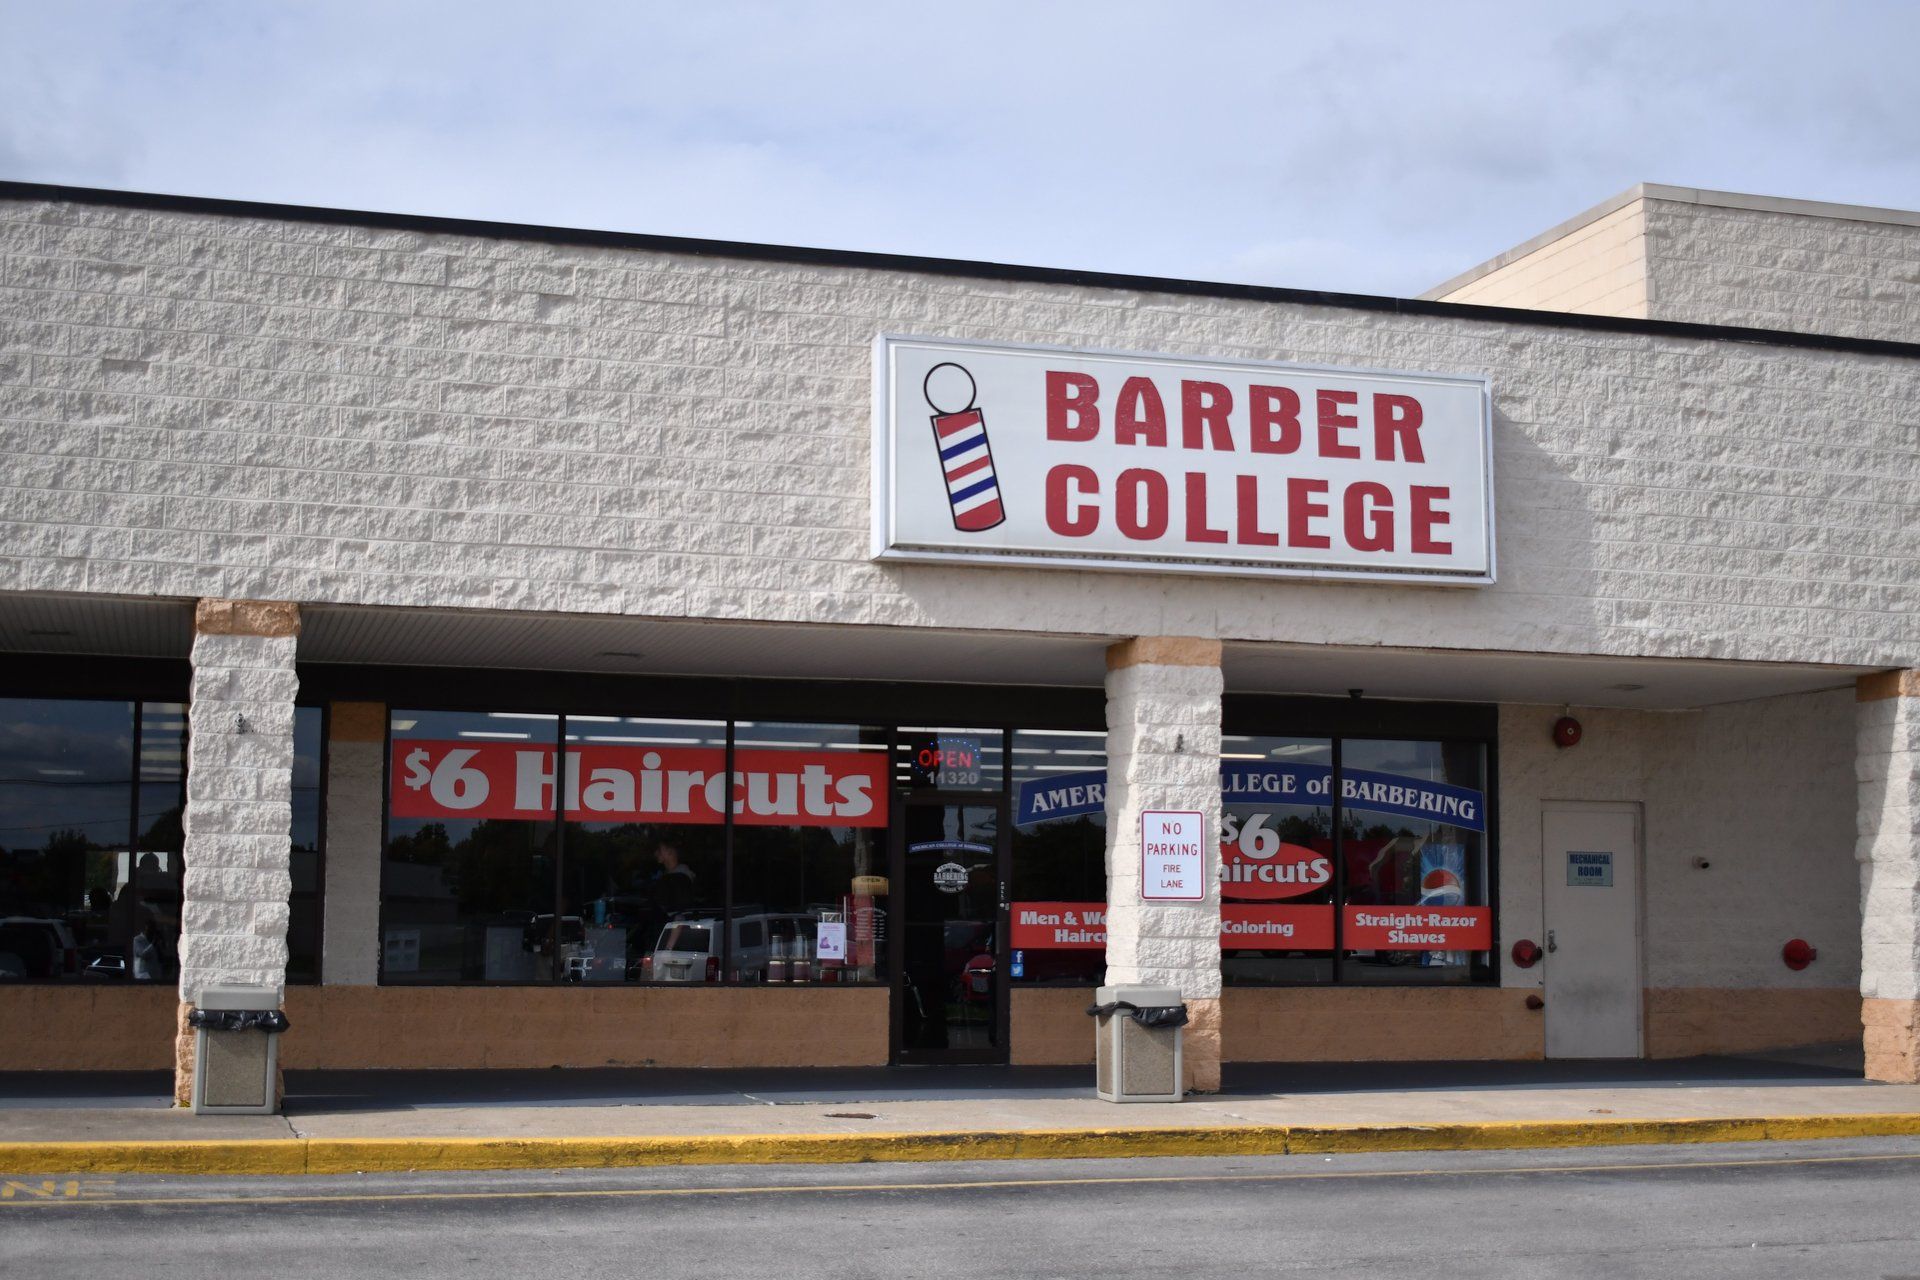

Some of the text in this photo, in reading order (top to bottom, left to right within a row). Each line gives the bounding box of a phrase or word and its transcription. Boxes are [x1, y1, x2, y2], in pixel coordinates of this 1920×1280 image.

[1045, 370, 1426, 464] BARBER
[1045, 464, 1453, 555] COLLEGE
[918, 749, 973, 768] OPEN
[404, 747, 873, 817] $6 Haircuts
[927, 771, 979, 785] 11320
[1031, 773, 1475, 820] AMER LLEGE of BARBERING
[1162, 822, 1182, 835] NO
[1220, 812, 1281, 860] $6
[1147, 843, 1198, 856] PARKING
[1569, 854, 1610, 864] MECHANICAL
[1163, 864, 1181, 873] FIRE
[1578, 866, 1602, 876] ROOM
[1160, 880, 1183, 888] LANE
[1020, 911, 1060, 925] Men
[1063, 911, 1078, 926] &
[1355, 913, 1477, 929] Straight-Razor
[1221, 920, 1294, 937] Coloring
[1388, 930, 1446, 944] Shaves
